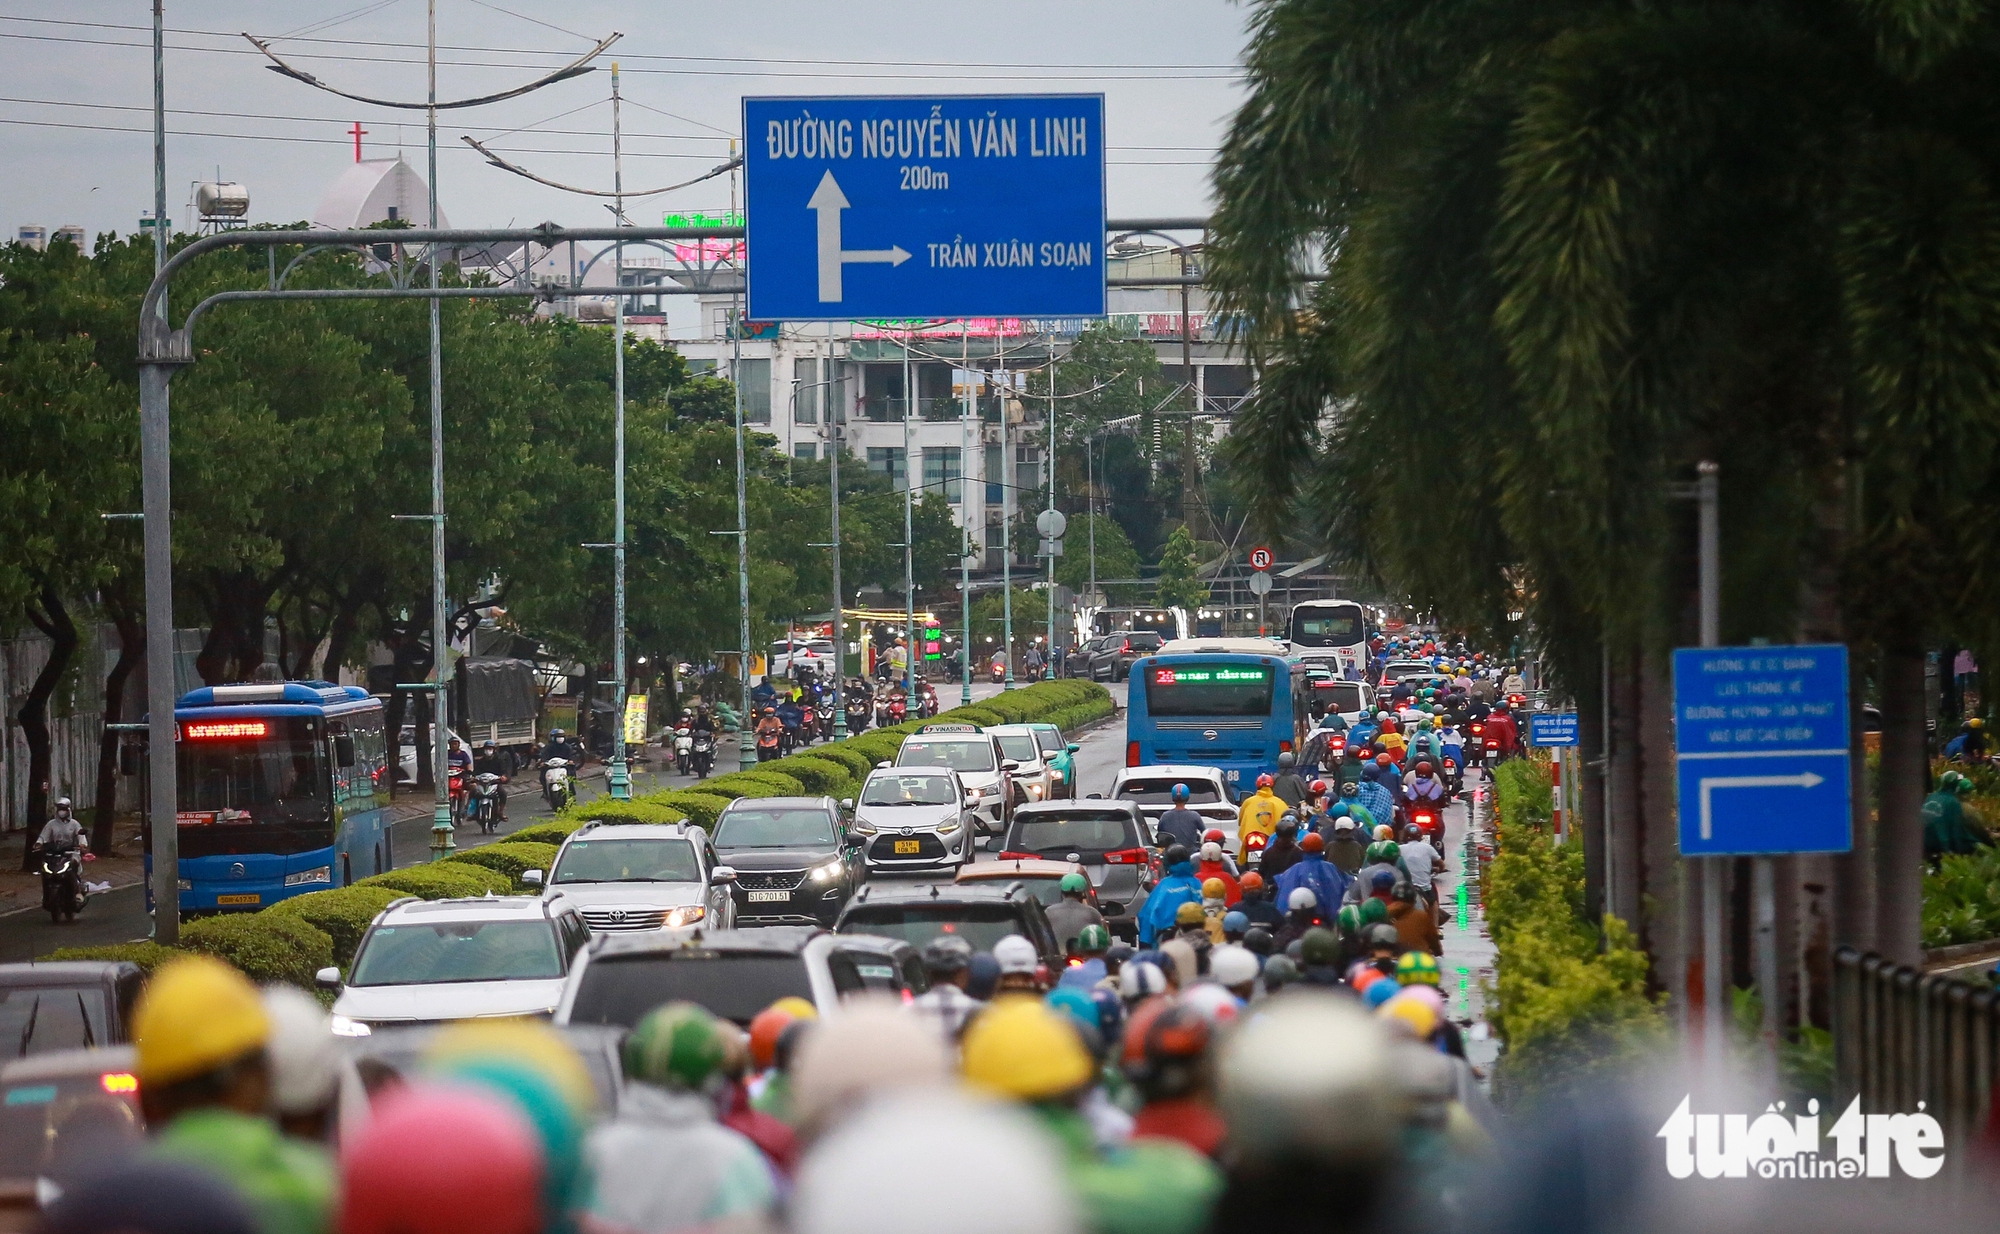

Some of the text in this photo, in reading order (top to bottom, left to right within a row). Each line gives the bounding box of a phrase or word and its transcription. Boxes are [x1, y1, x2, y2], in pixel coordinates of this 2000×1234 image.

[767, 105, 1087, 159] ĐƯỜNG NGUYỄN VĂN LINH
[900, 165, 949, 190] 200m
[927, 233, 1091, 271] TRẦN XUÂN SOẠN
